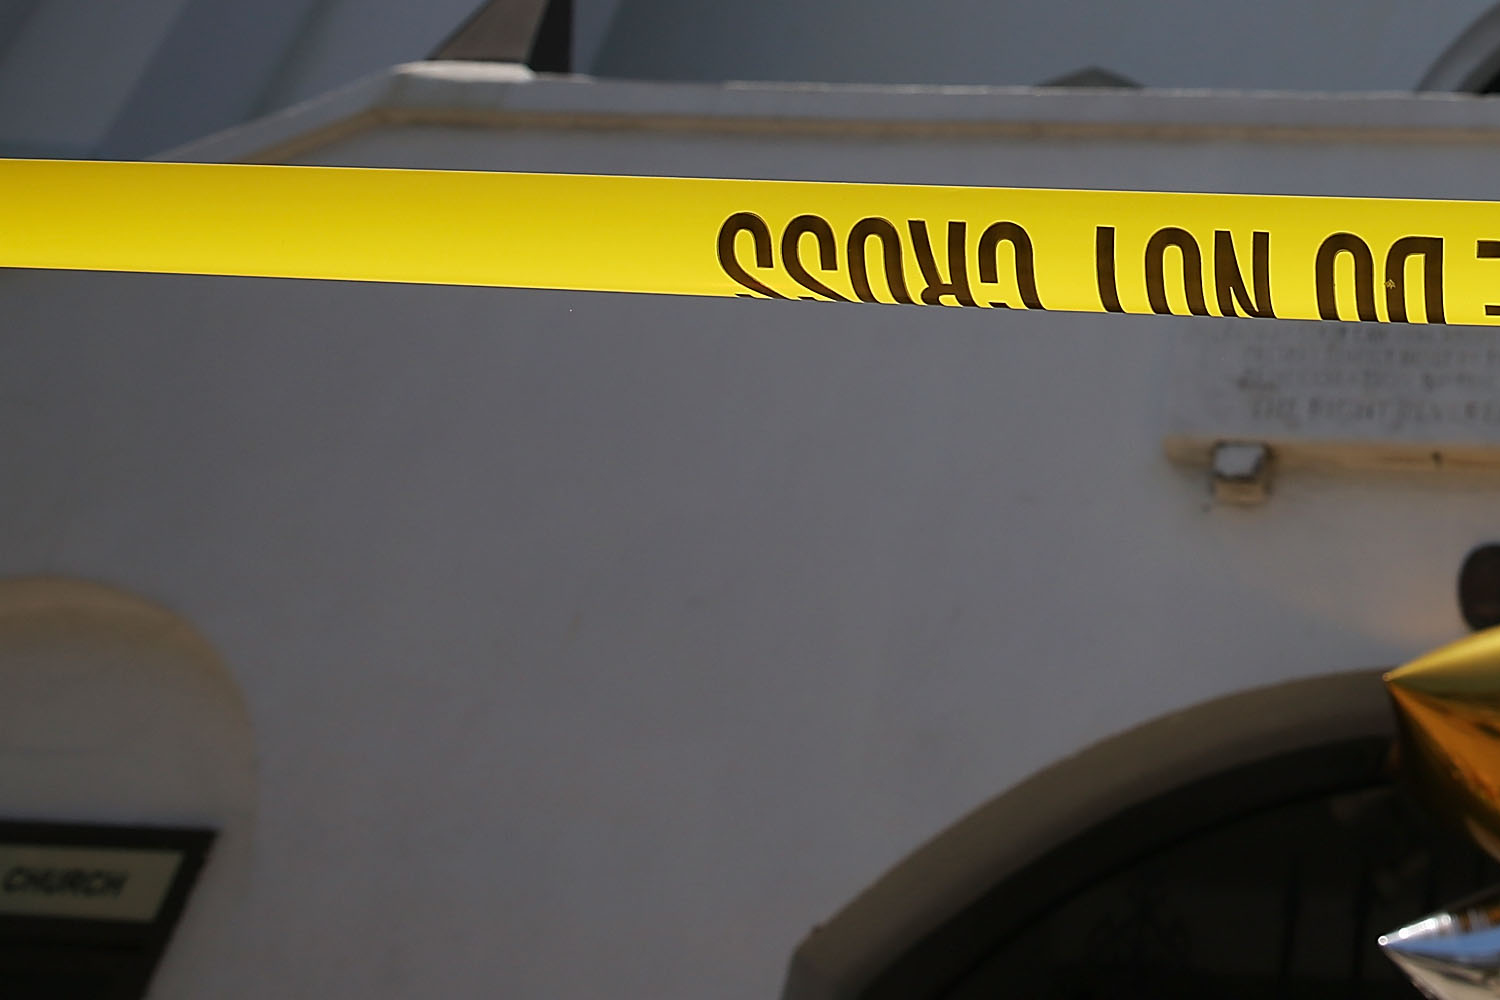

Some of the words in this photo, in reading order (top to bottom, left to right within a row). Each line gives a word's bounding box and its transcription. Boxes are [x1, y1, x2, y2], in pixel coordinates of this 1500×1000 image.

[717, 211, 1043, 307] CROSS
[1316, 233, 1446, 323] DO
[3, 867, 131, 898] CHURCH
